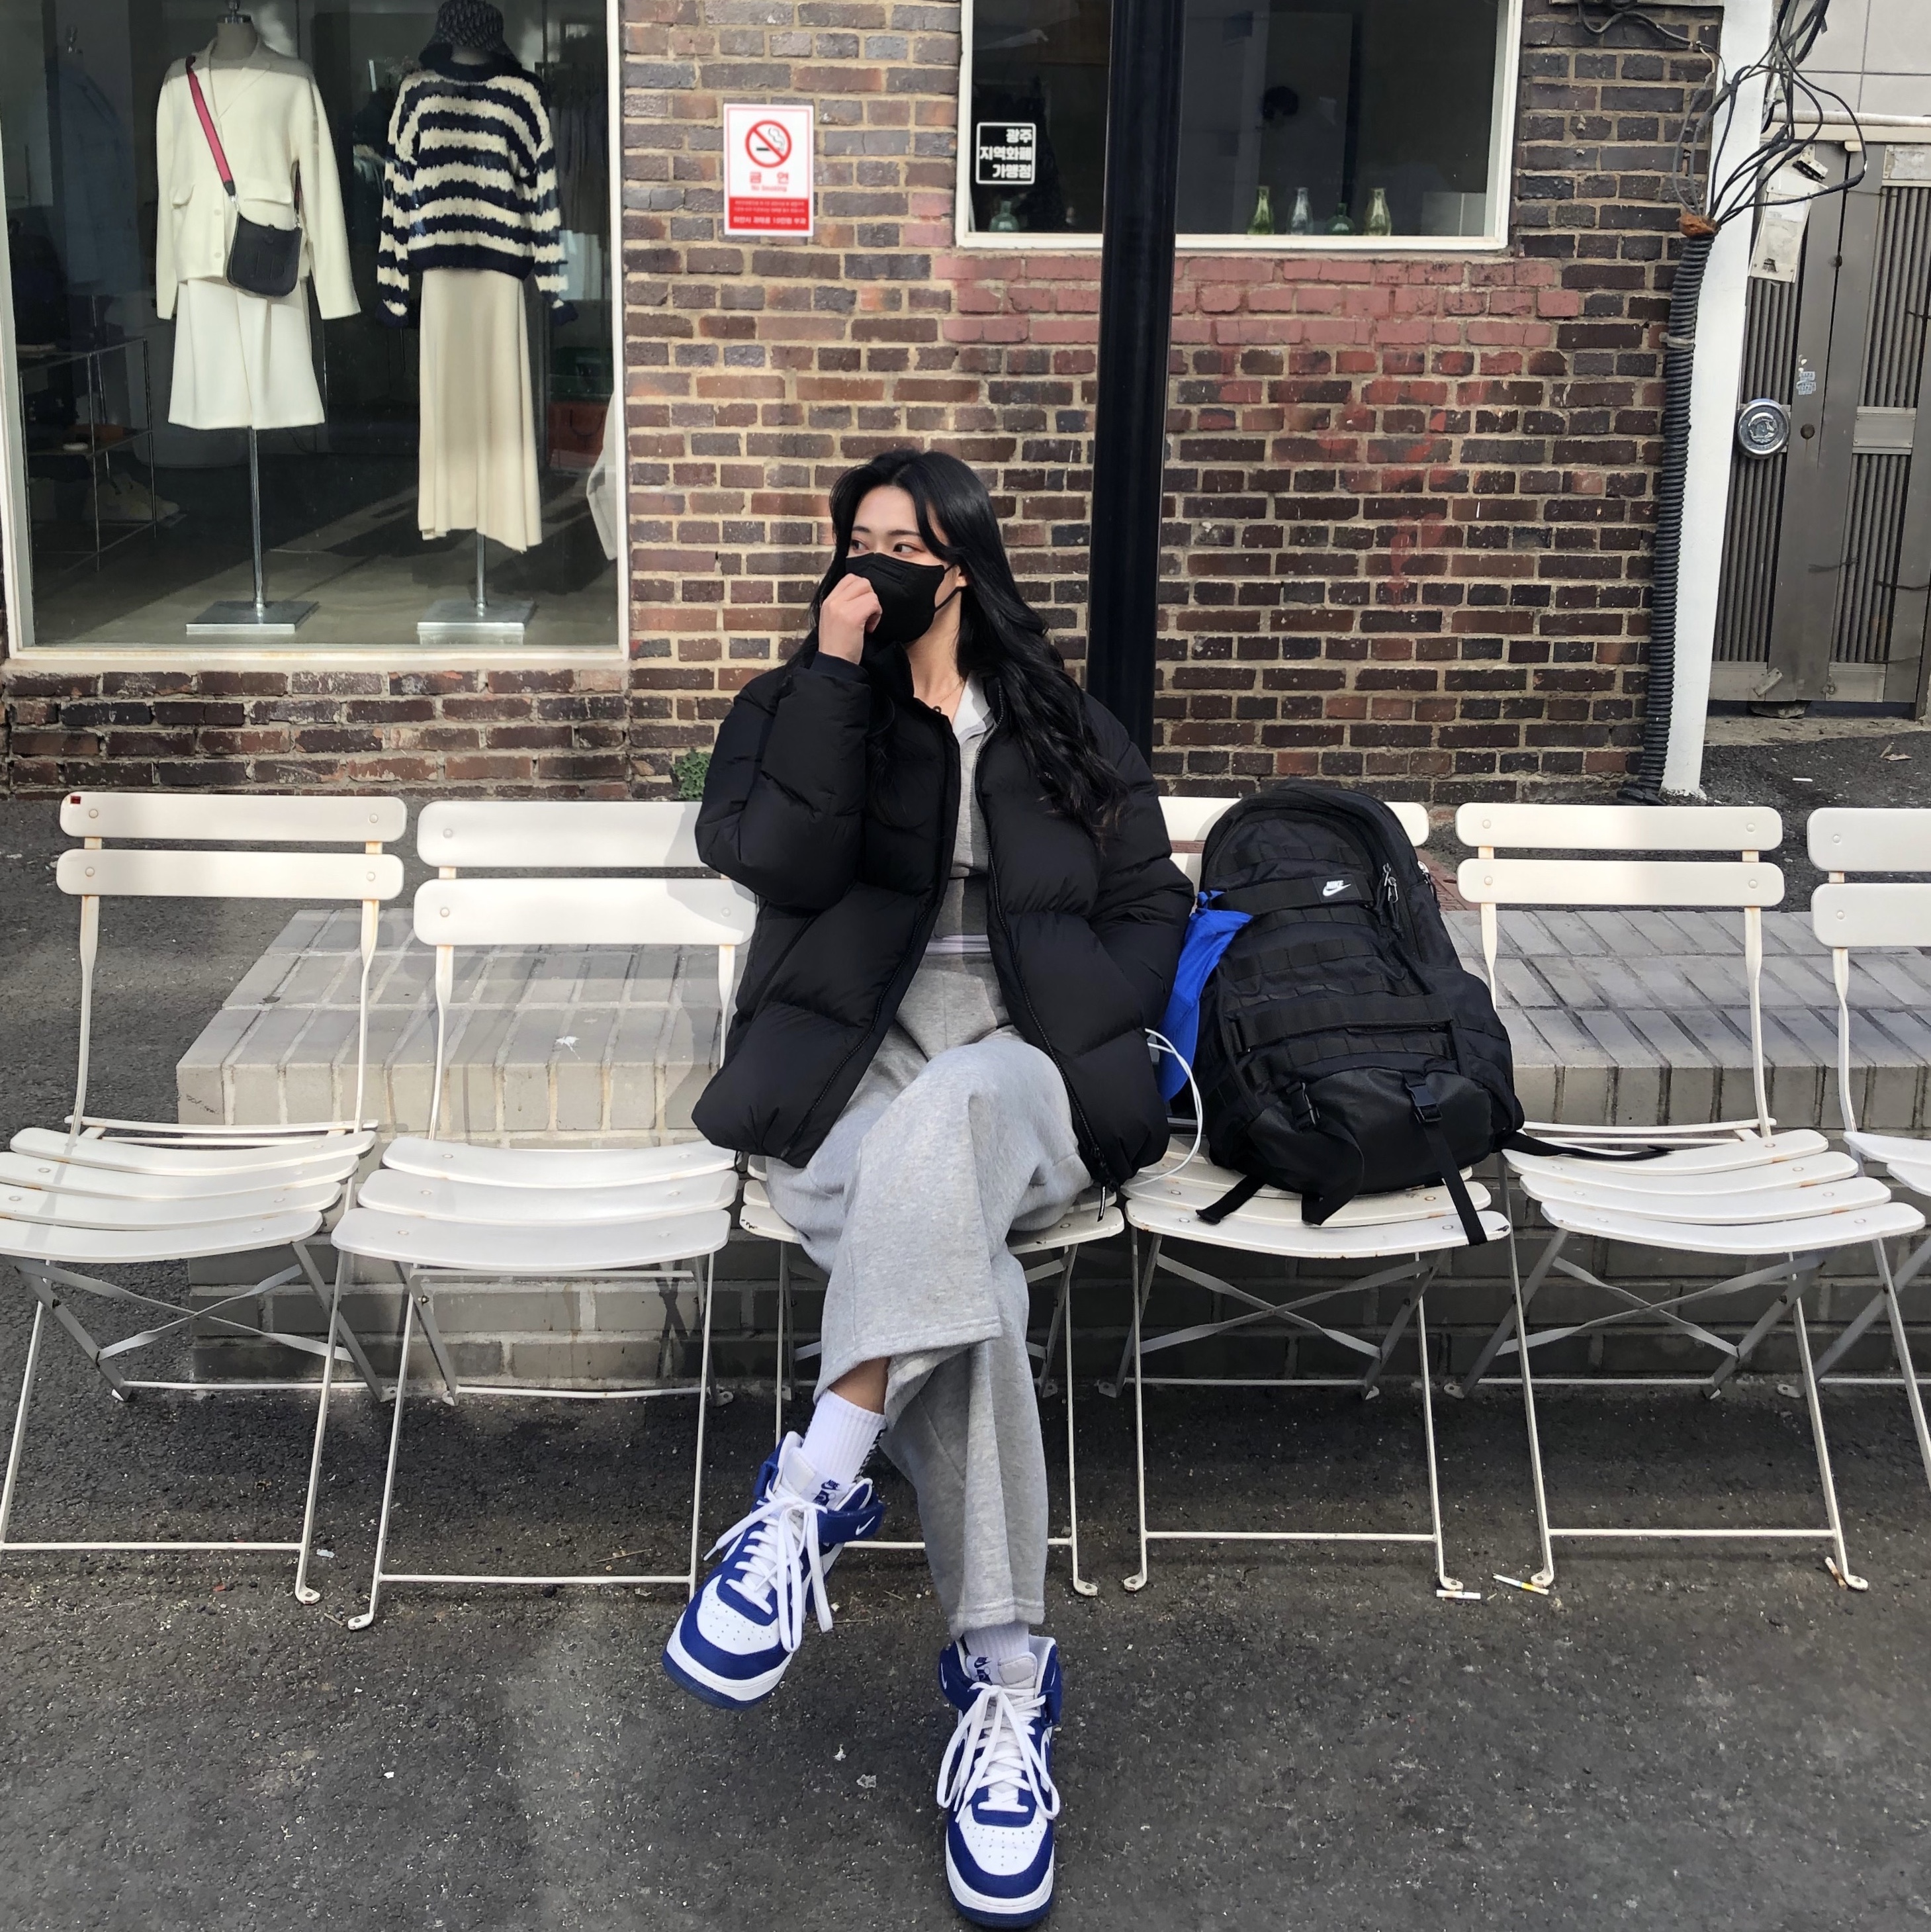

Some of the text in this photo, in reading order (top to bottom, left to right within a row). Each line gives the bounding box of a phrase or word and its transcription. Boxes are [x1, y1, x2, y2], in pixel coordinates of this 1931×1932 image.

[1006, 128, 1032, 143] 광주
[979, 146, 1032, 161] 지역화폐
[992, 163, 1032, 179] 가맹점
[1326, 880, 1344, 890] NIKE
